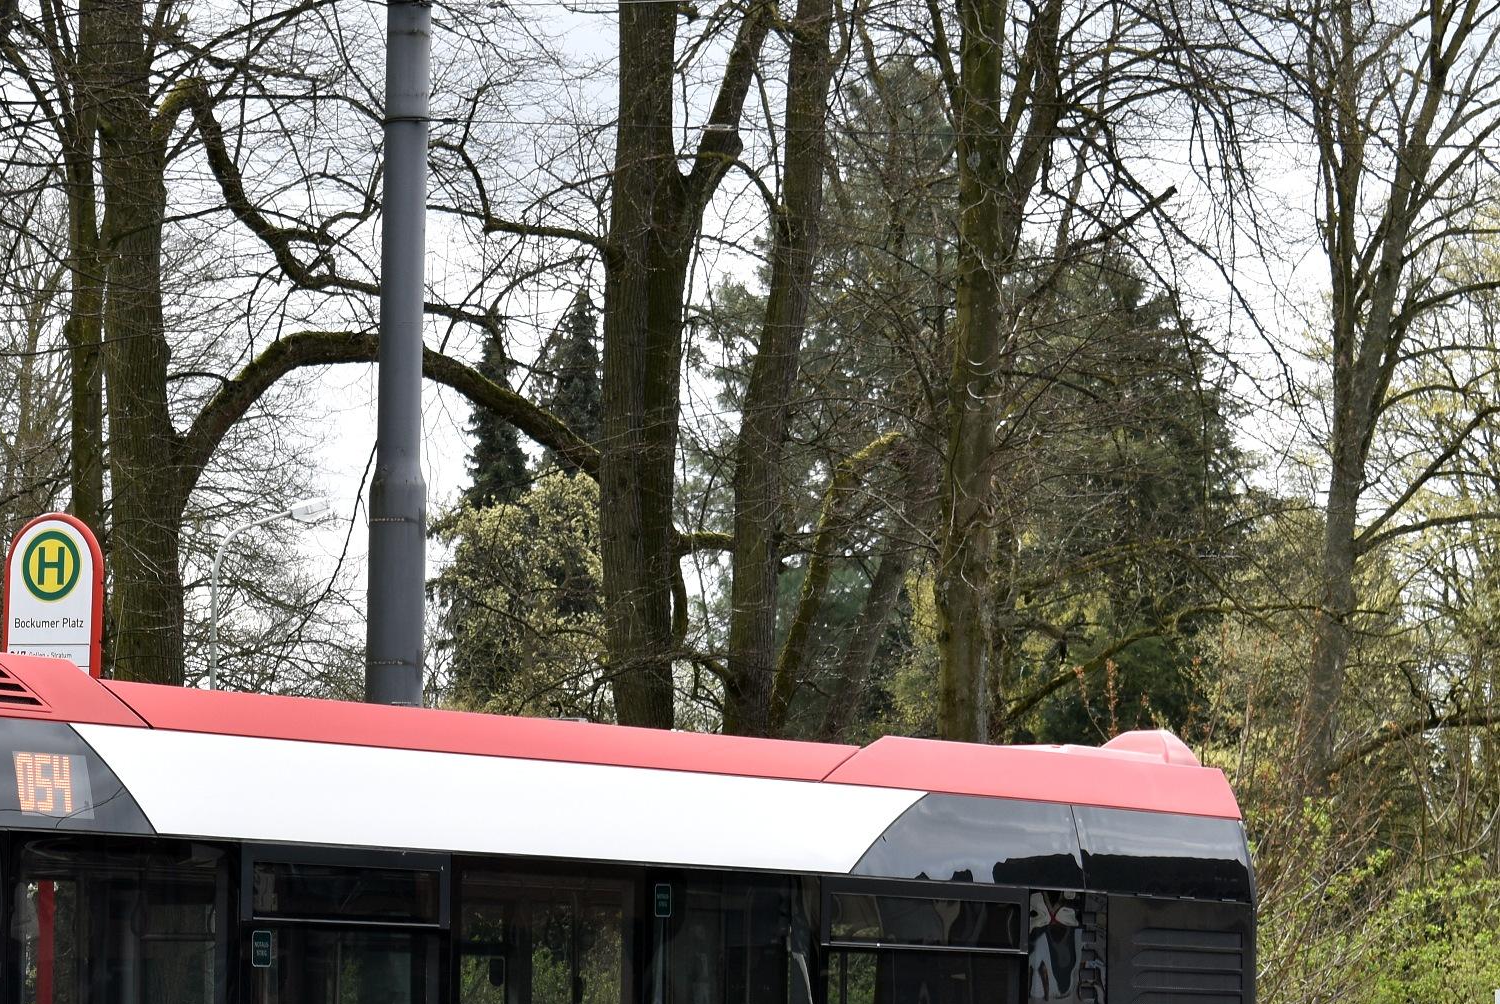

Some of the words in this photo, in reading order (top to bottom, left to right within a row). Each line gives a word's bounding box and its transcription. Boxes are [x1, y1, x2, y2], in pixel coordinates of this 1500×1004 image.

[38, 546, 65, 585] H
[14, 618, 59, 628] Bockumer
[62, 618, 84, 628] Platz
[16, 754, 72, 812] 054
